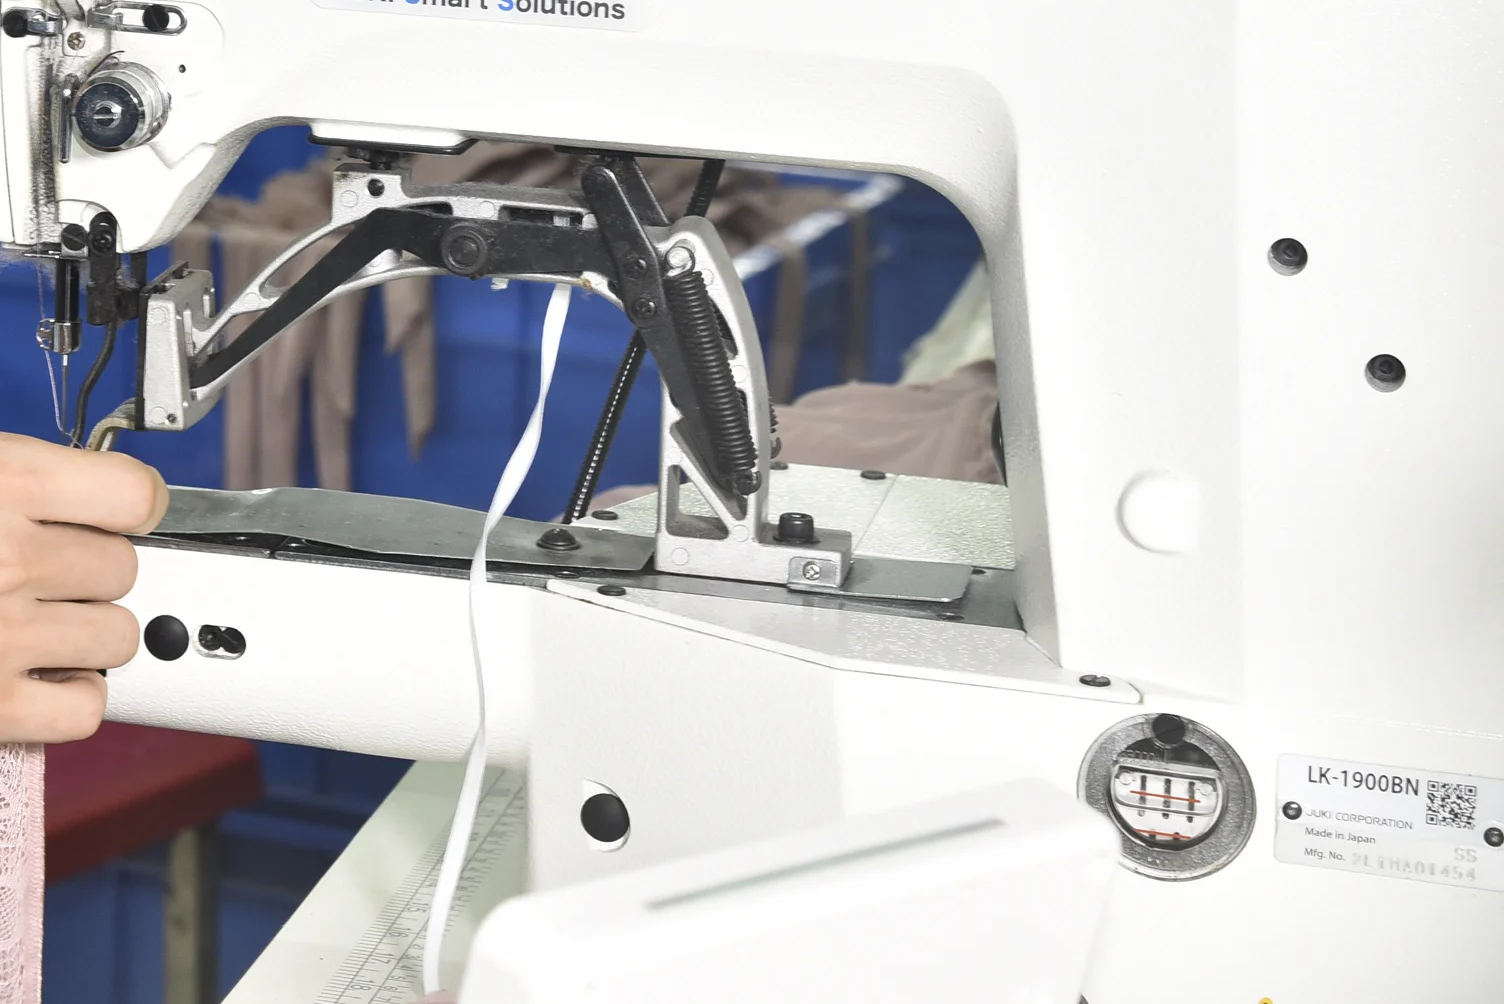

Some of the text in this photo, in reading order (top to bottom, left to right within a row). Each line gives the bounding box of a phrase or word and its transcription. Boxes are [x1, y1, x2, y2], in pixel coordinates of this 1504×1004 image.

[1307, 765, 1419, 796] LK-1900BN
[1306, 809, 1413, 830] JUKI CORPORATION
[1305, 827, 1376, 844] Made in Japan
[1304, 847, 1326, 860] Mfg.
[1328, 851, 1345, 861] No.
